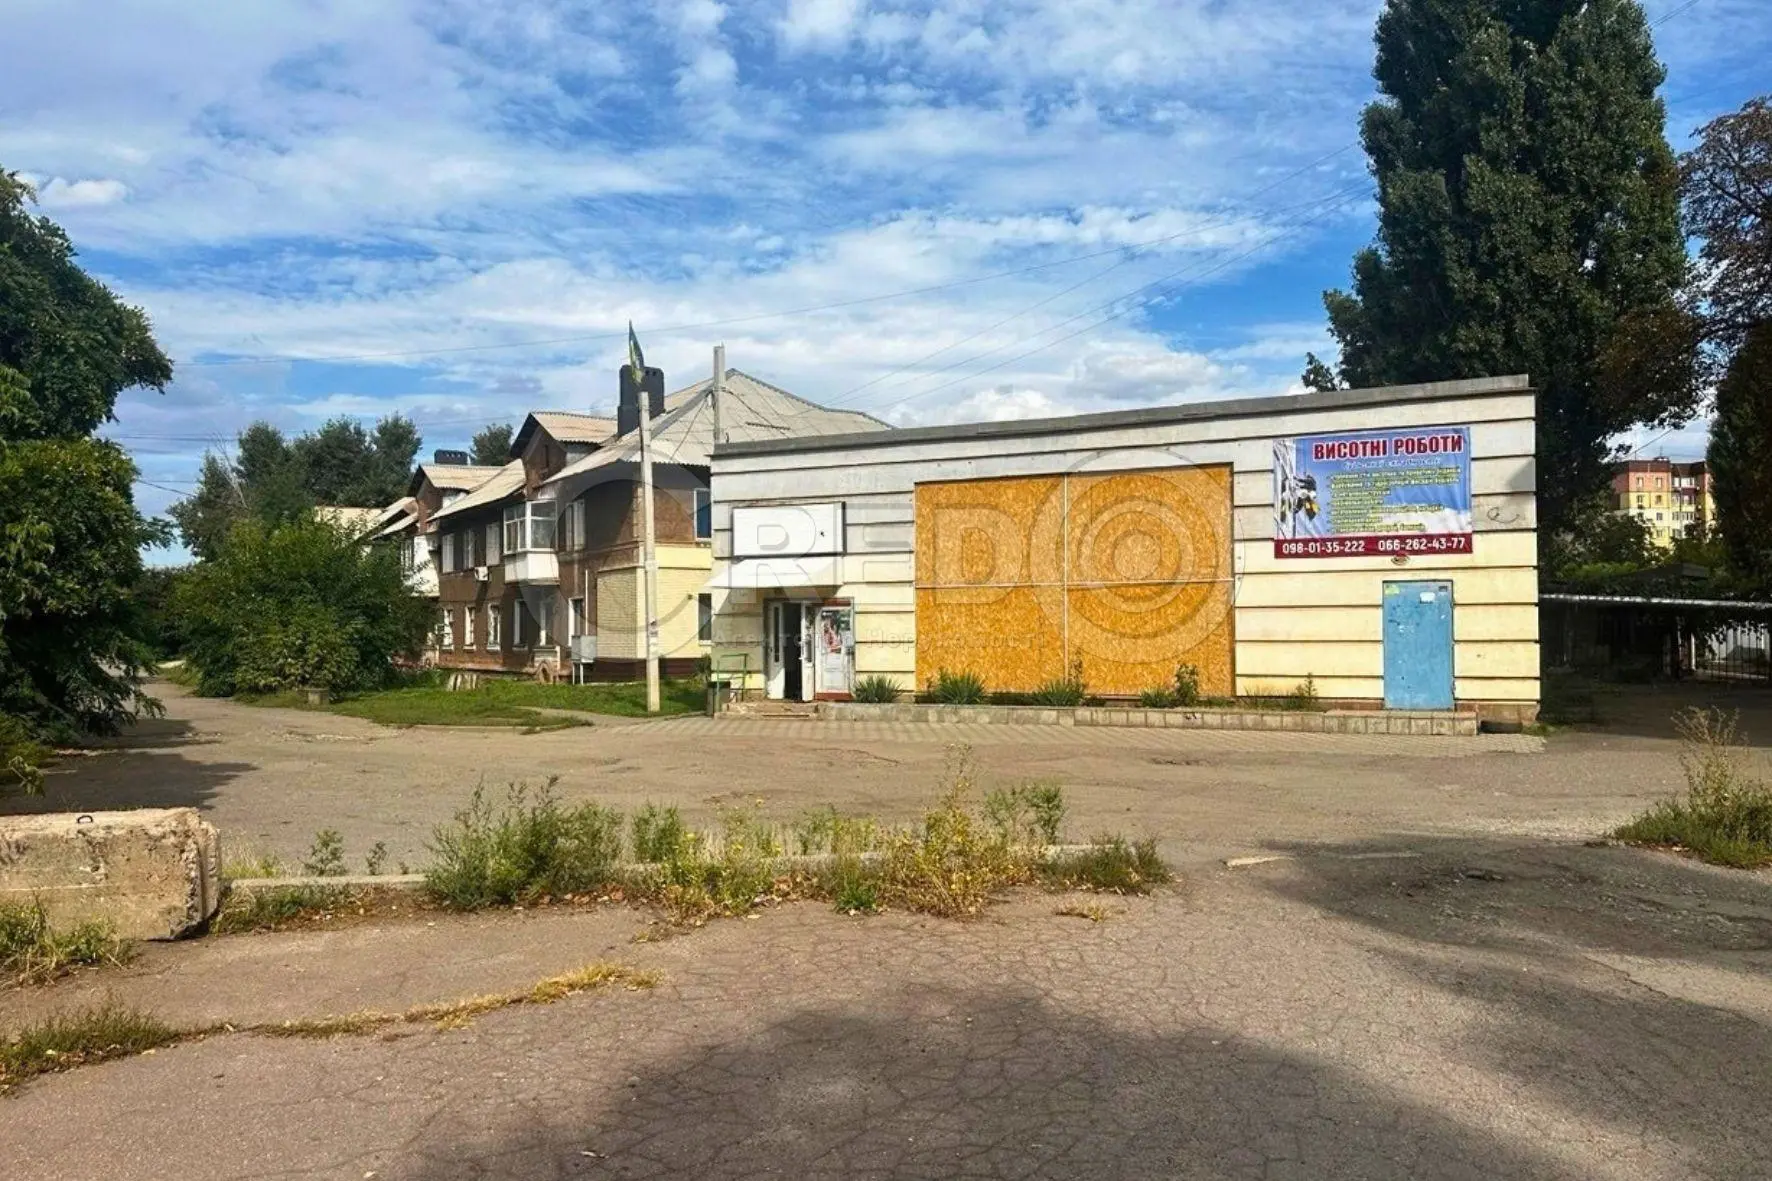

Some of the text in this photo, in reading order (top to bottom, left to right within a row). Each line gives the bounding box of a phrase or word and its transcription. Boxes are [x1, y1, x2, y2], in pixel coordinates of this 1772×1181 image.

[1314, 435, 1463, 460] ВИСОТНІ РОБОТИ
[1282, 537, 1466, 554] 098-01-35-222 066-262-43-77
